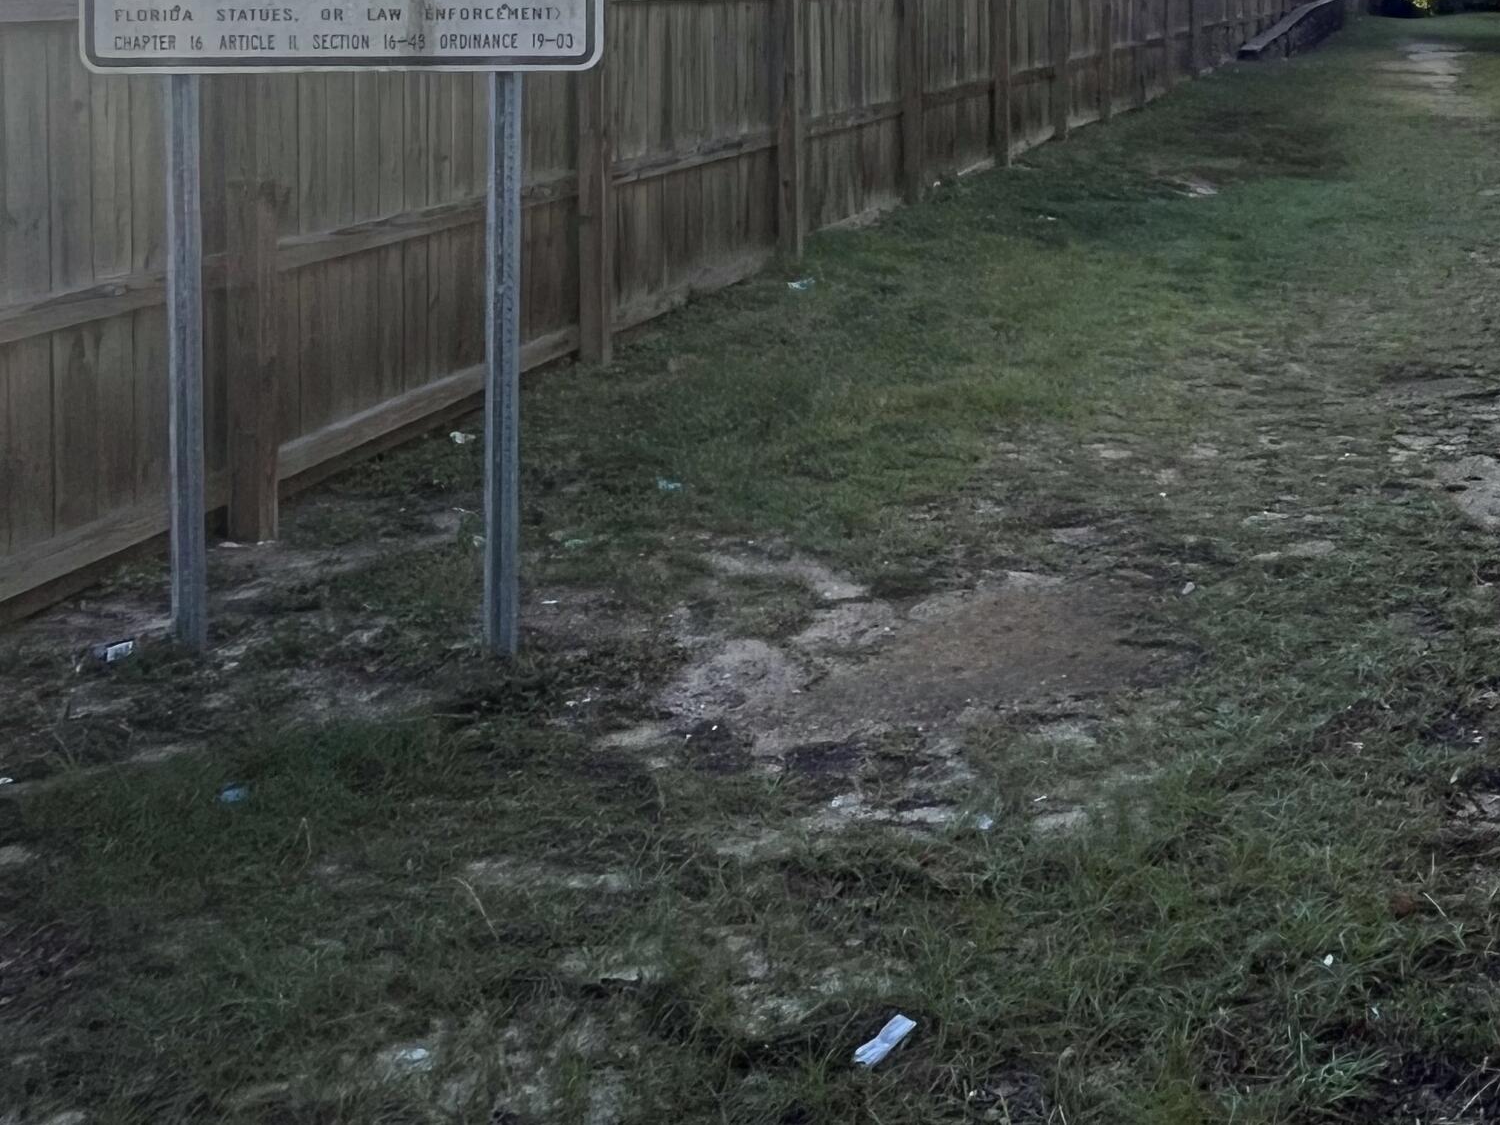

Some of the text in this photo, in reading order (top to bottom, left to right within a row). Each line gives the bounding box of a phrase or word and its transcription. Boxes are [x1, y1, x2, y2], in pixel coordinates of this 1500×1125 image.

[114, 7, 193, 22] FLORIDA
[321, 8, 344, 21] OR
[367, 7, 401, 21] LAW
[114, 35, 176, 51] CHAPTER
[191, 34, 203, 51] 16
[219, 34, 275, 50] ARTICLE
[313, 34, 370, 50] SECTION
[440, 33, 518, 49] ORDINANCE
